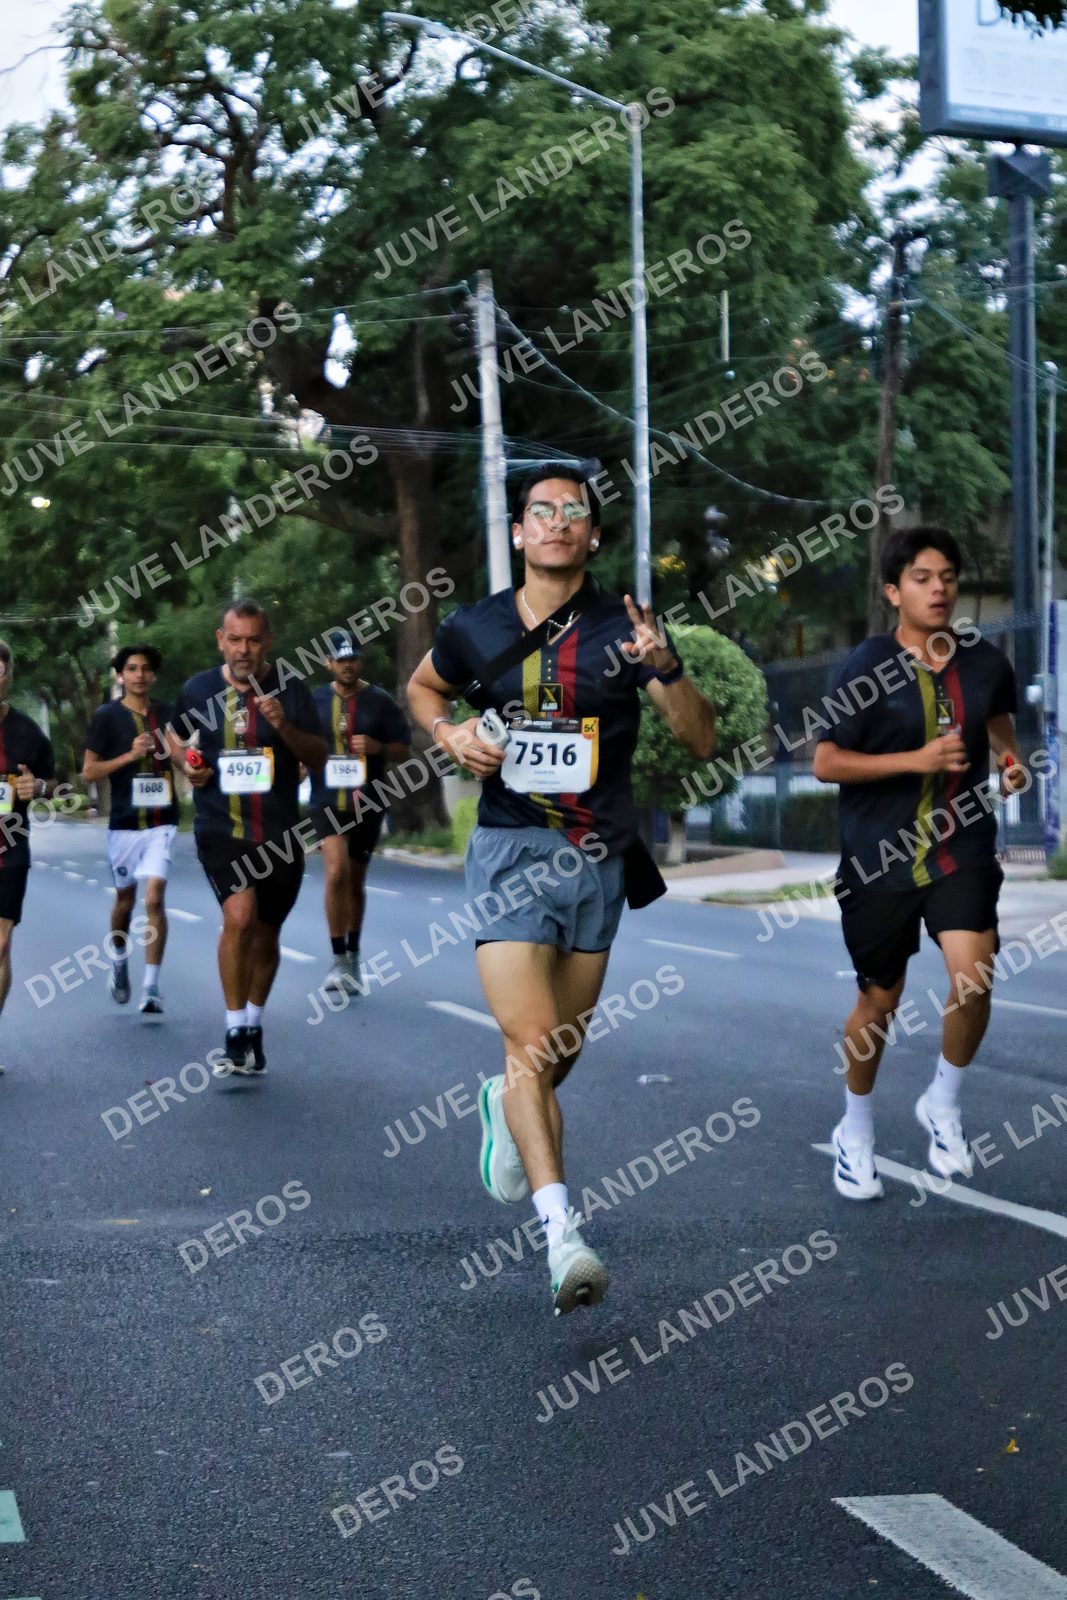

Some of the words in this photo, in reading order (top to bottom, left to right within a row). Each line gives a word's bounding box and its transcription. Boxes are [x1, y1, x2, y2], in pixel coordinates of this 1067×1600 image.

[514, 740, 577, 766] 7516
[226, 761, 262, 776] 4967
[139, 781, 164, 793] 1608
